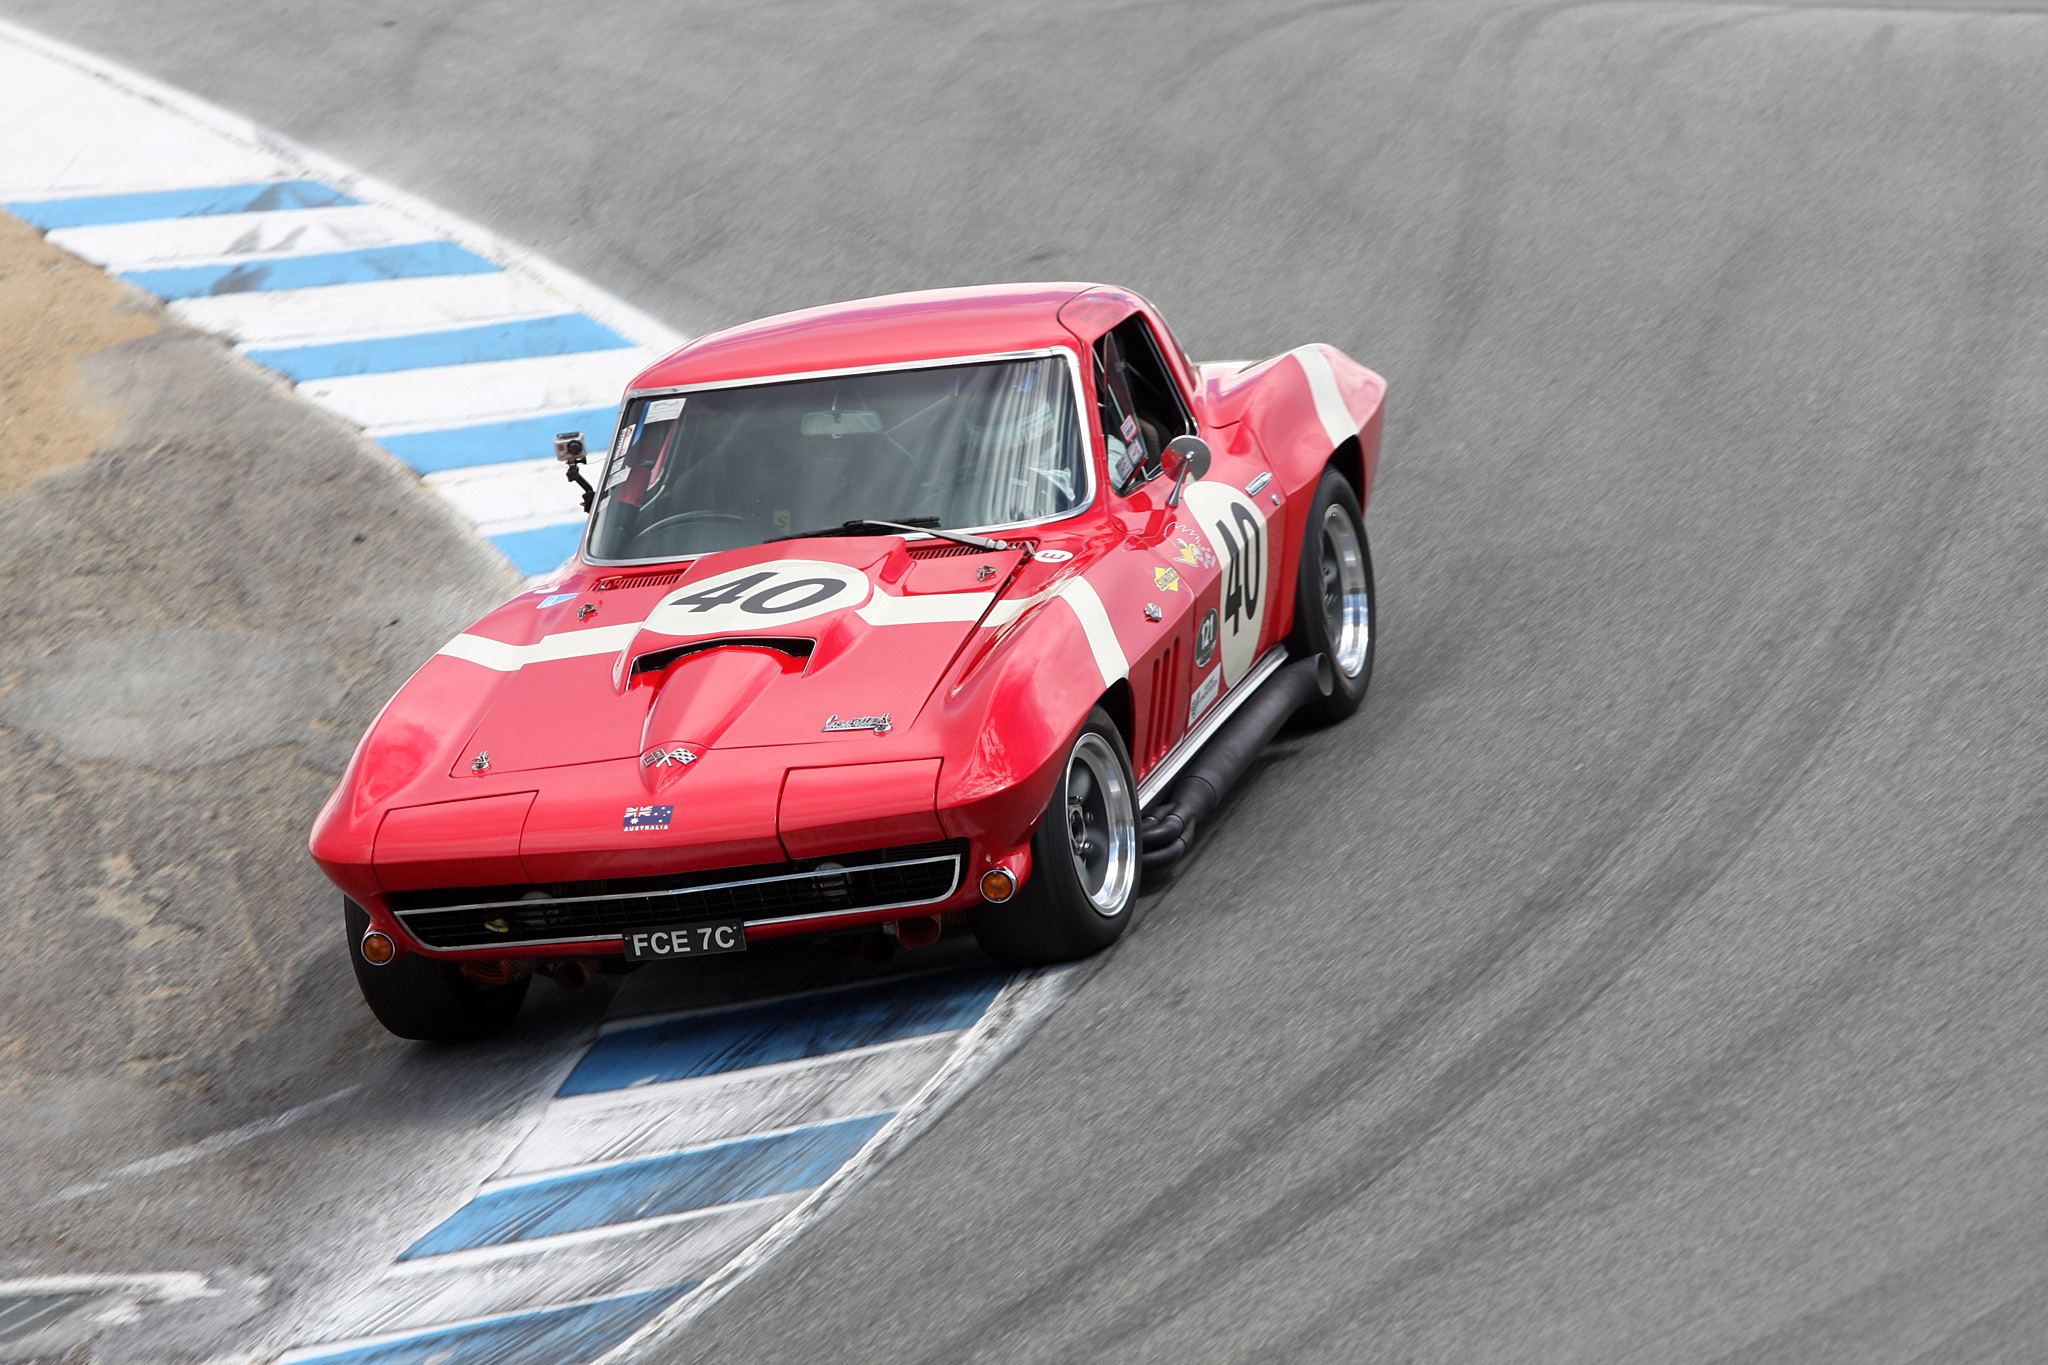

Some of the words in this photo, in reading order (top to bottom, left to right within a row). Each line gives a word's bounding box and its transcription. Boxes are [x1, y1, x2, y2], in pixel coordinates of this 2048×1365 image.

[1215, 502, 1260, 637] 40
[669, 571, 847, 614] 40
[623, 824, 669, 832] AUSTRALIA
[632, 932, 691, 956] FCE
[697, 926, 735, 950] 7C
